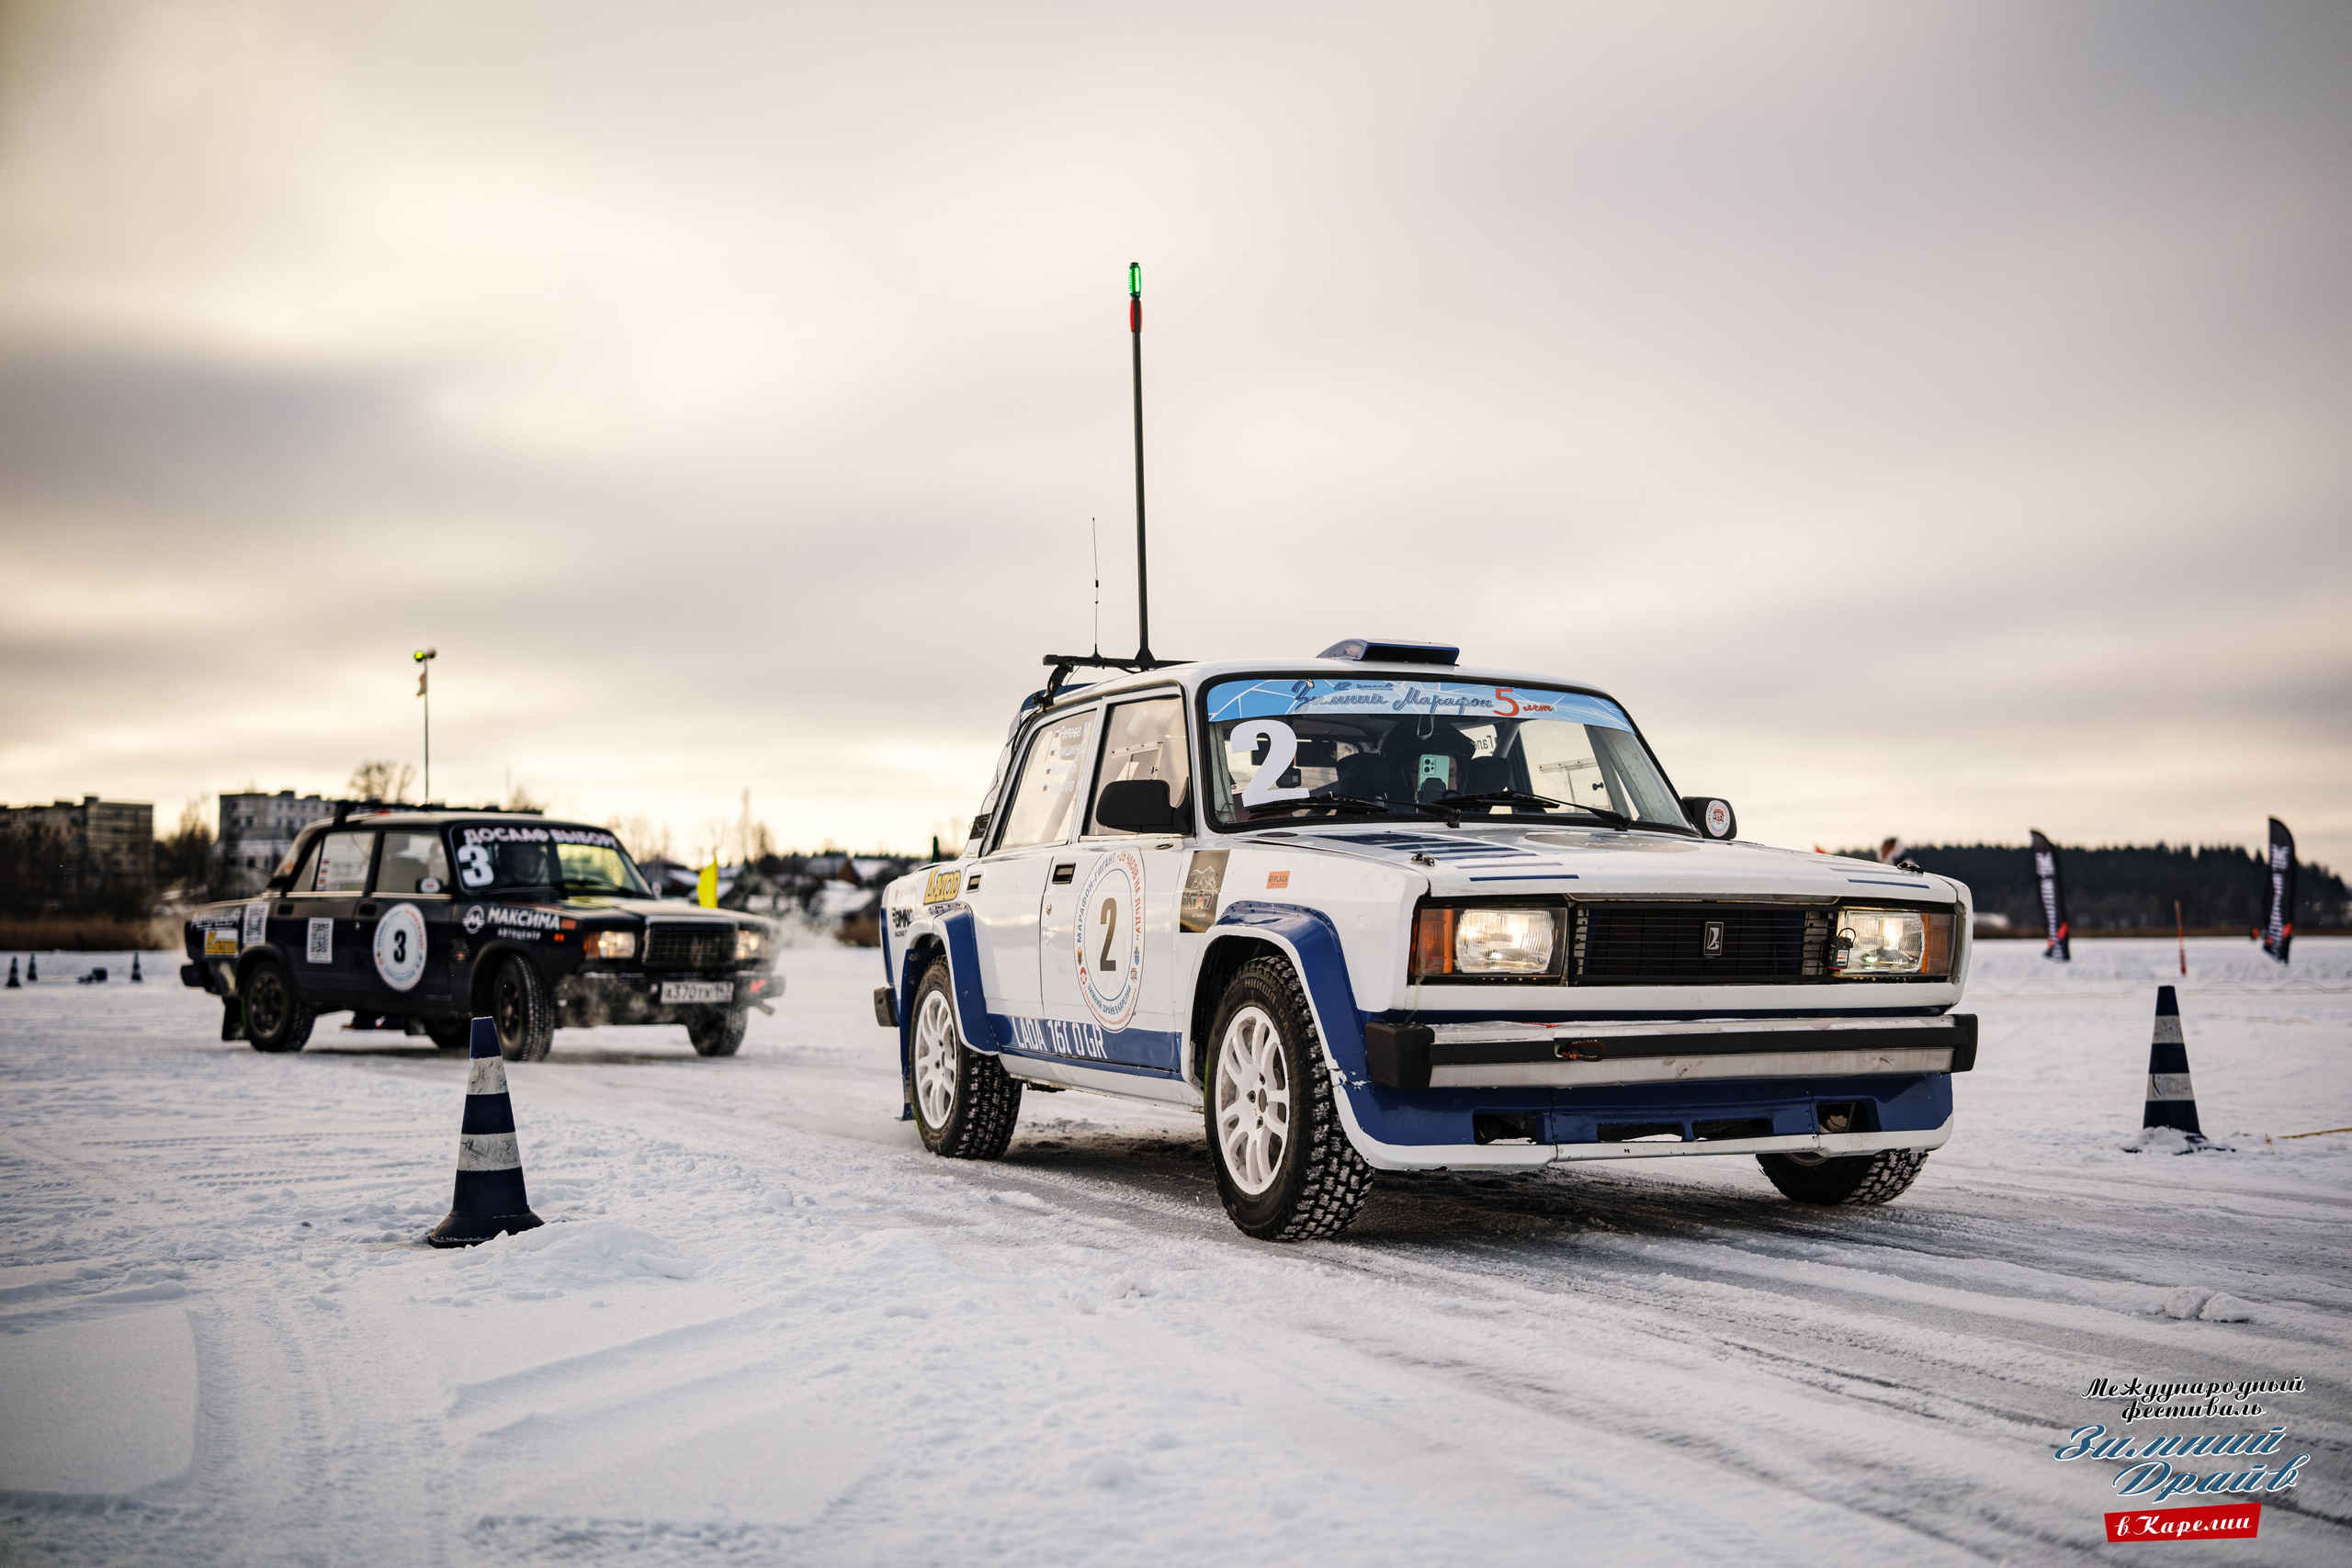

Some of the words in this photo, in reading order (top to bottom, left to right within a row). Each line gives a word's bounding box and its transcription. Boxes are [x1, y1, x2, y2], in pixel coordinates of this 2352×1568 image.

[1291, 679, 1388, 713] Зимний
[1392, 687, 1494, 715] Марафон
[1493, 687, 1520, 716] 5
[1522, 704, 1554, 713] лет
[1229, 719, 1309, 807] 2
[458, 844, 494, 888] 3
[487, 907, 560, 930] МАКСИМА
[1100, 897, 1117, 971] 2
[393, 929, 406, 964] 3
[1012, 1016, 1047, 1052] LADA
